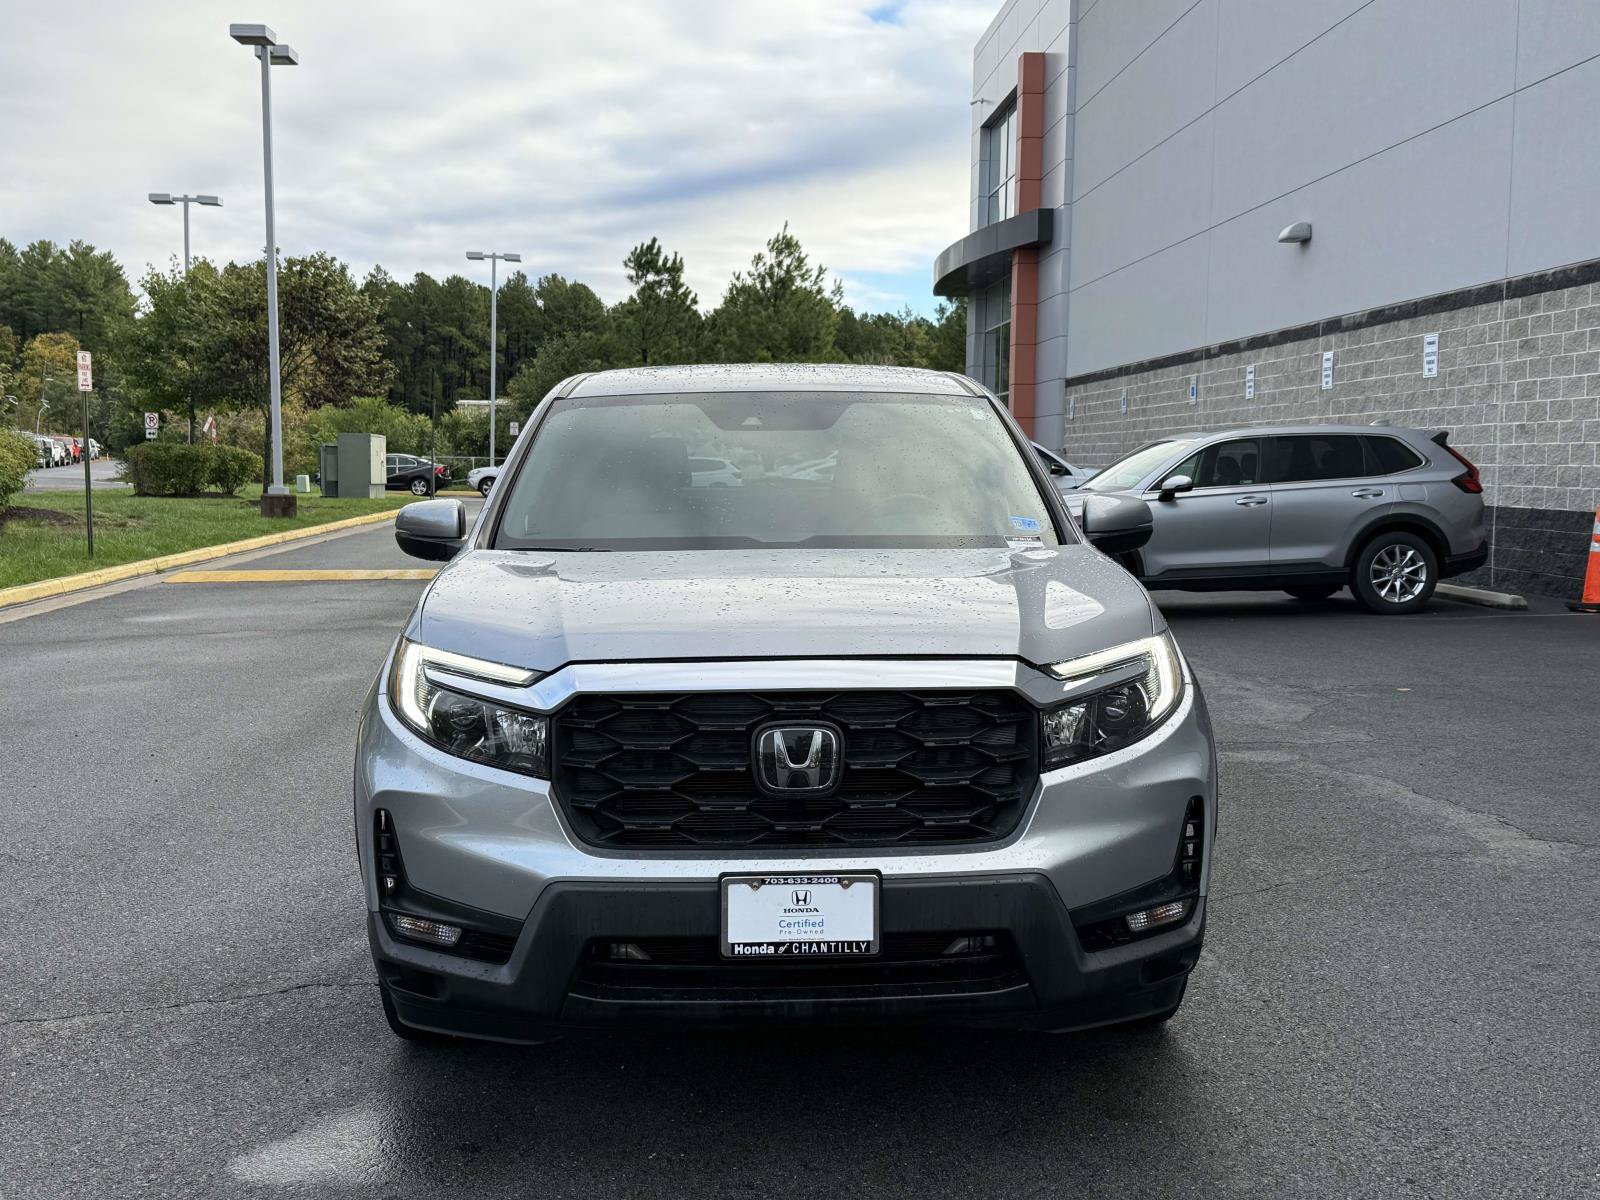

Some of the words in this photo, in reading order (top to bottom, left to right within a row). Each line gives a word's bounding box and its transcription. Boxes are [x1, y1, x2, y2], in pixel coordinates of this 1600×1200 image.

[778, 918, 824, 928] Certified
[734, 944, 774, 954] Honda
[778, 943, 790, 954] of
[792, 942, 867, 954] CHANTILLY
